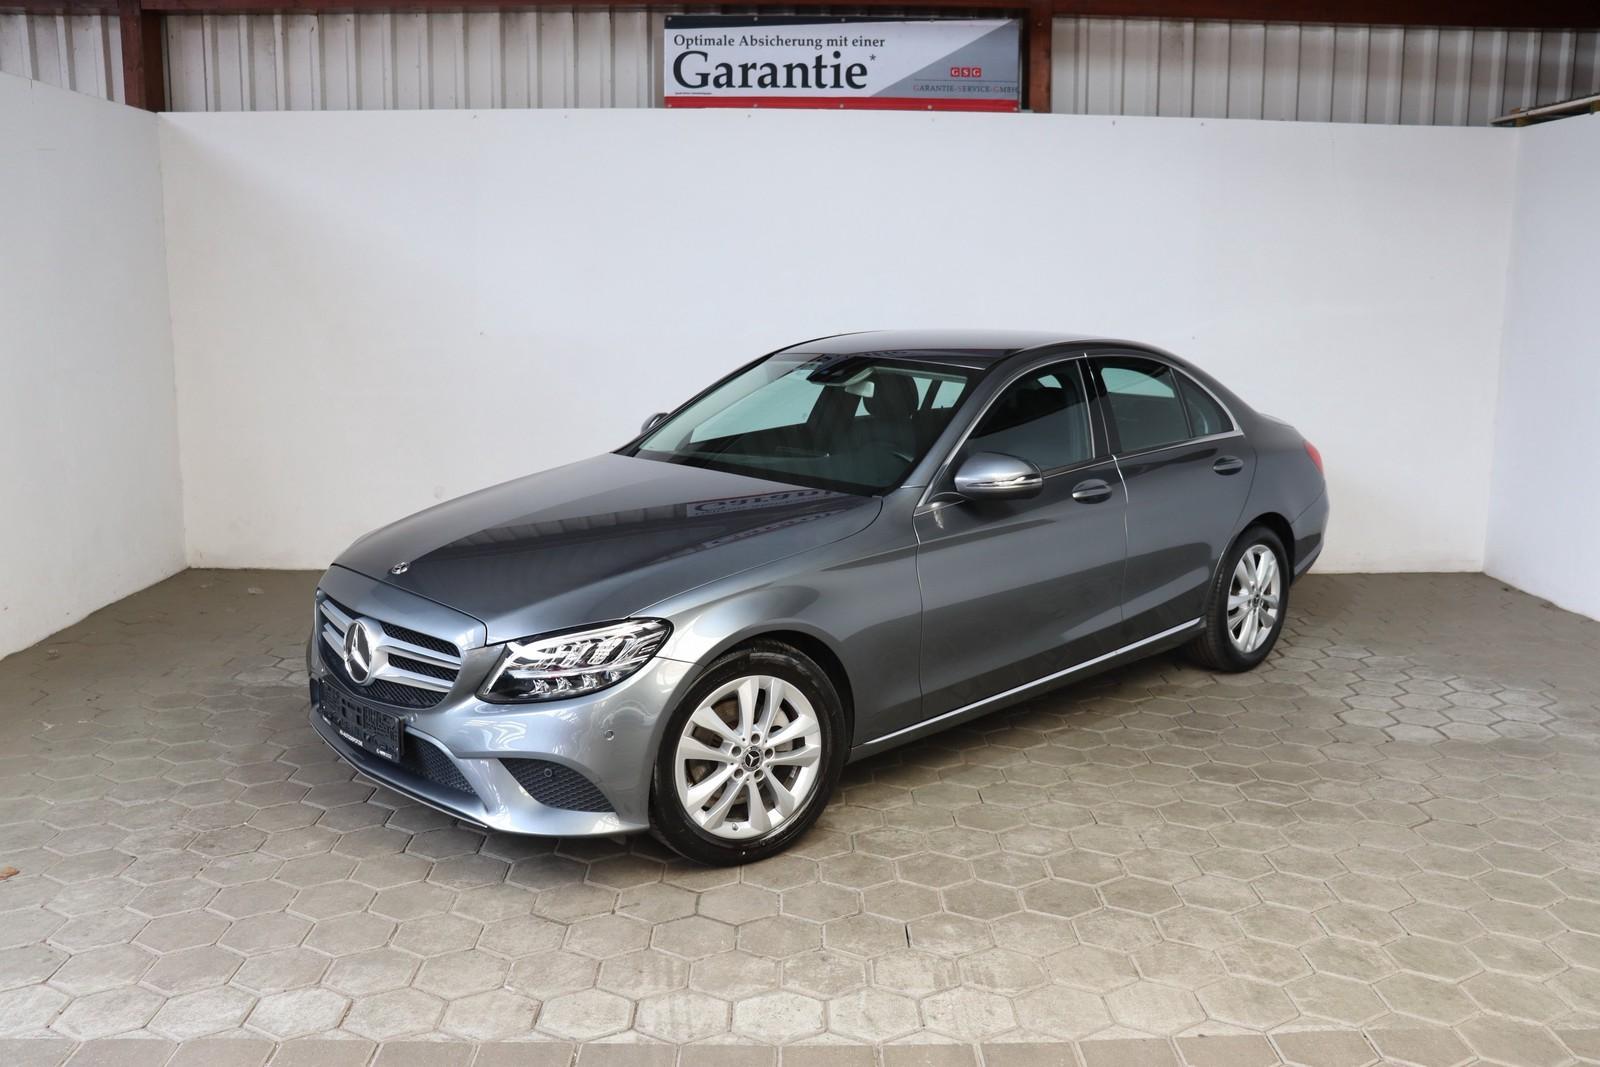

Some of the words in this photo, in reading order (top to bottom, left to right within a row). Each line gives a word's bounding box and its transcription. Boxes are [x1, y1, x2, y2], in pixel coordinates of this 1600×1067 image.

[674, 34, 735, 49] Optimale
[739, 35, 822, 50] Absicherung
[826, 35, 848, 47] mit
[852, 35, 885, 47] einer
[951, 67, 981, 77] GSG
